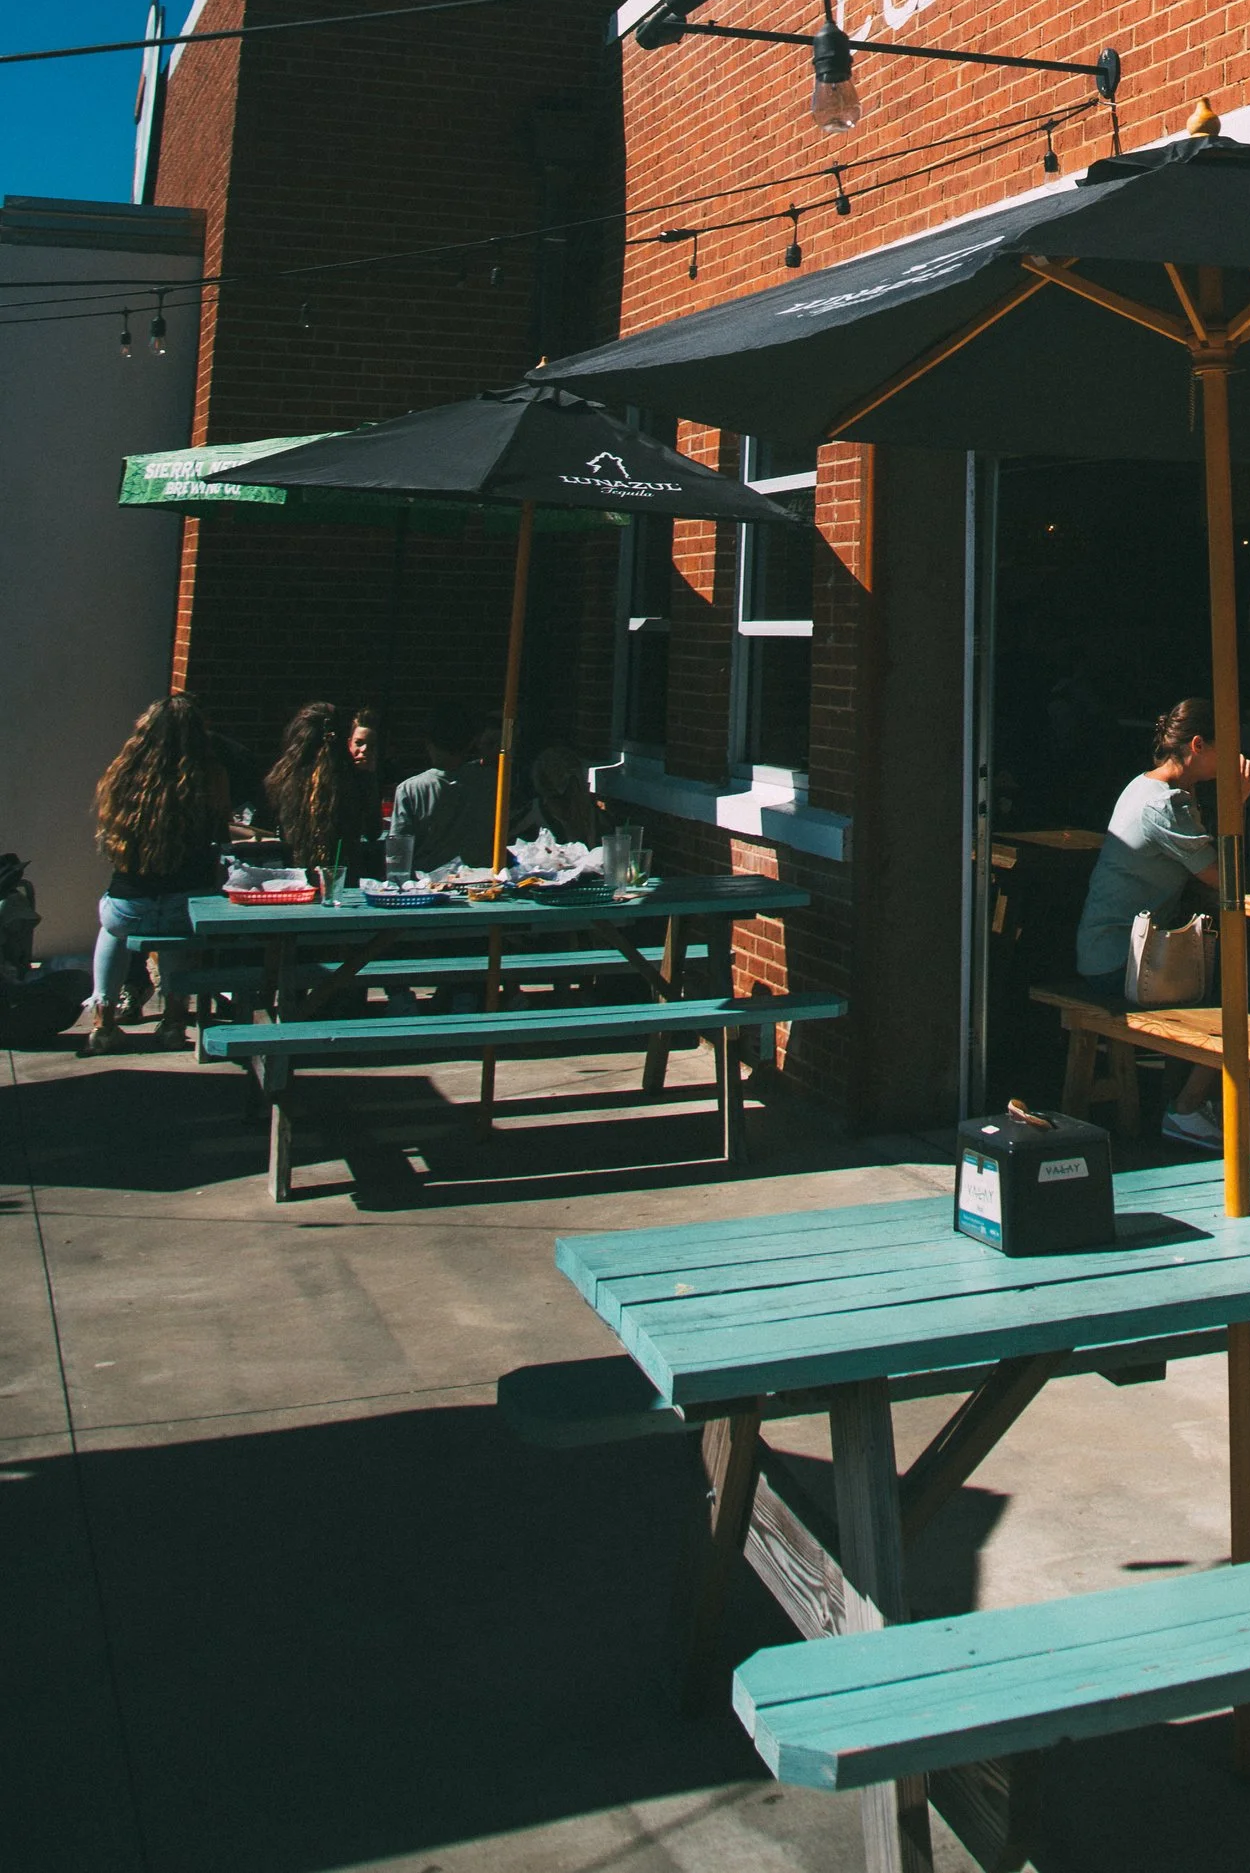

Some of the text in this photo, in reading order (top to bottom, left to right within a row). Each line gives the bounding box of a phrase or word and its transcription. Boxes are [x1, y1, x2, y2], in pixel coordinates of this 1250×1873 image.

[144, 461, 203, 480] SIERRA
[164, 481, 220, 496] BREWING
[558, 474, 682, 491] LUNAZUL
[600, 487, 655, 498] Tequila
